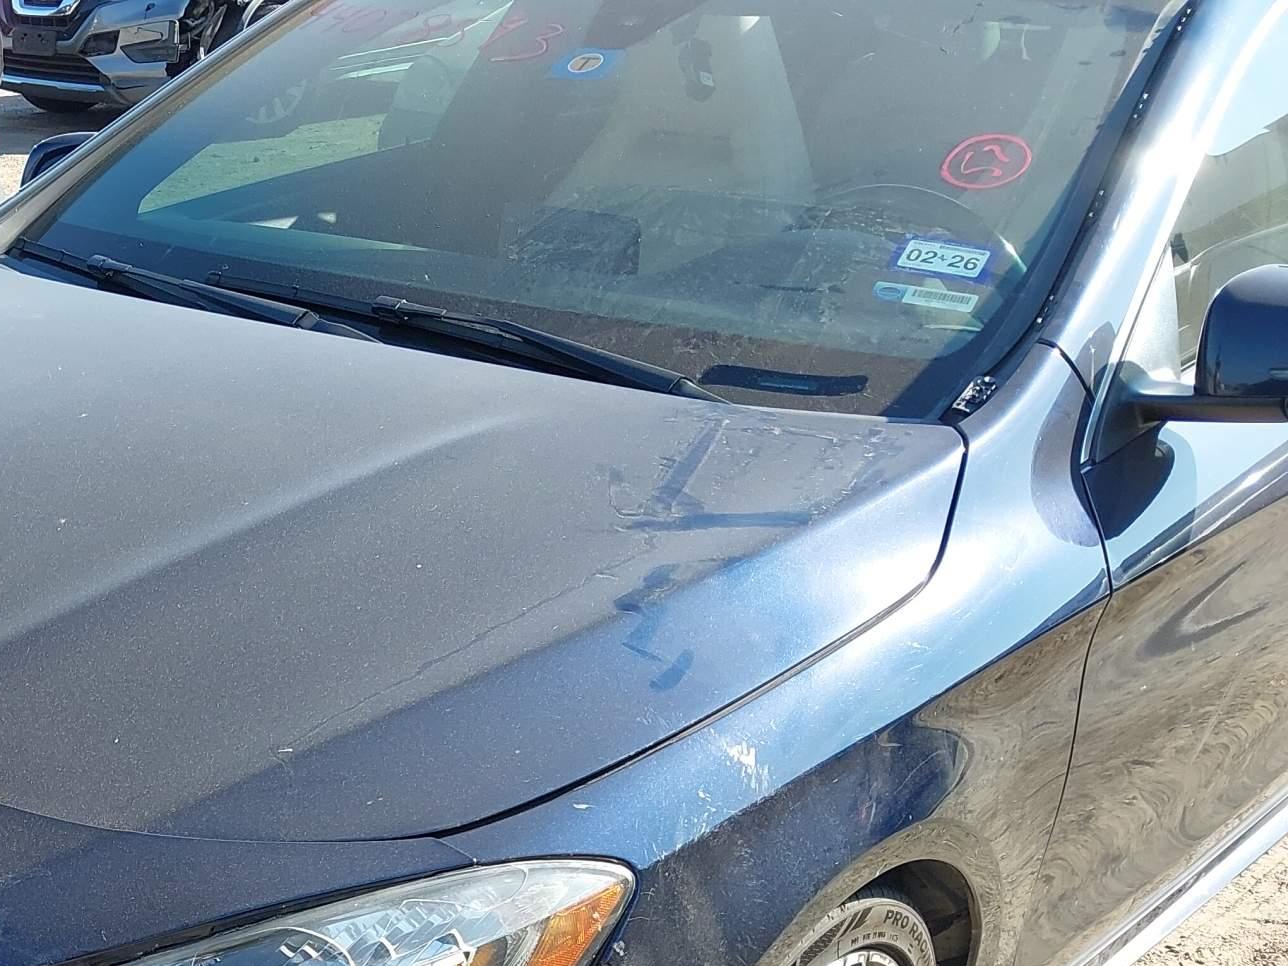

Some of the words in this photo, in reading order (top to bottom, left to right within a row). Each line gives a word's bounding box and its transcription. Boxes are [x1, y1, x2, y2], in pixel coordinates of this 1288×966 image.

[906, 249, 938, 264] 02
[947, 255, 980, 271] 26
[883, 909, 910, 928] PRO
